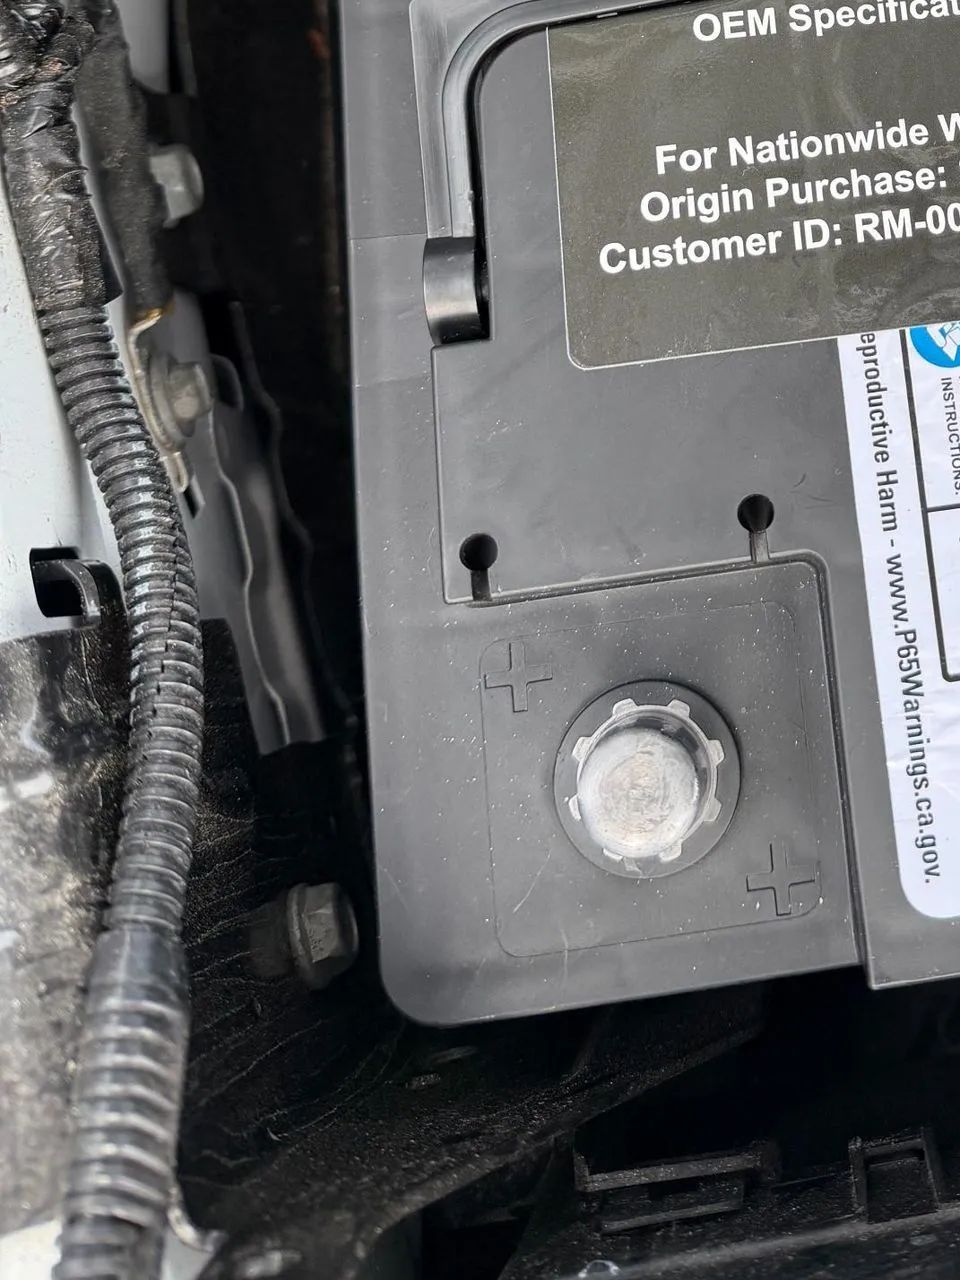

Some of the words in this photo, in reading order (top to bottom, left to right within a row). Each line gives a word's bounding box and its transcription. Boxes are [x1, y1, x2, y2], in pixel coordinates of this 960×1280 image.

[693, 8, 776, 41] OEM
[656, 144, 717, 174] For
[729, 120, 931, 171] Nationwide
[641, 184, 753, 223] Origin
[766, 167, 950, 208] Purchase:
[600, 232, 782, 273] Customer
[793, 219, 841, 250] ID:
[858, 333, 893, 464] eproductive
[876, 469, 899, 532] Harm
[887, 554, 940, 883] www.P65Warnings.ca.gov.
